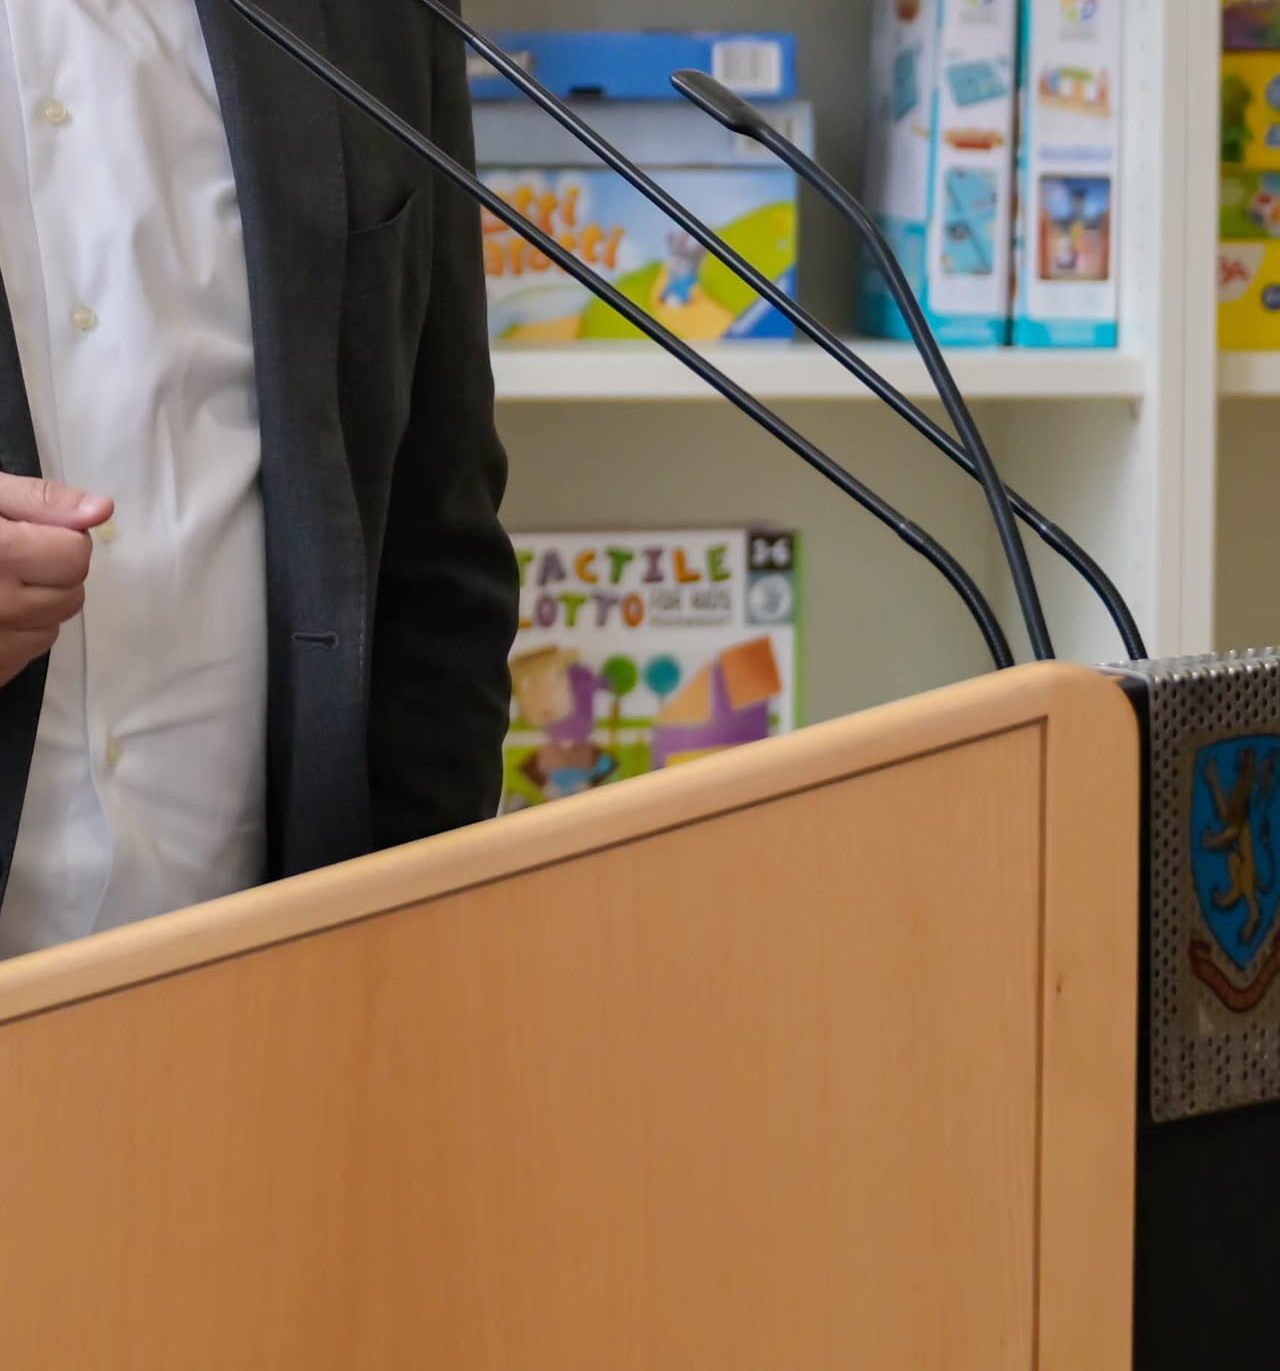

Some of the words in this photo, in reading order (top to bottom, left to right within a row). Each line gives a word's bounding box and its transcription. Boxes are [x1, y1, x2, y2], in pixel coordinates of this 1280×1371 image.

[484, 223, 624, 277] arotti
[517, 544, 732, 587] TACTILE
[519, 591, 645, 629] OTTO
